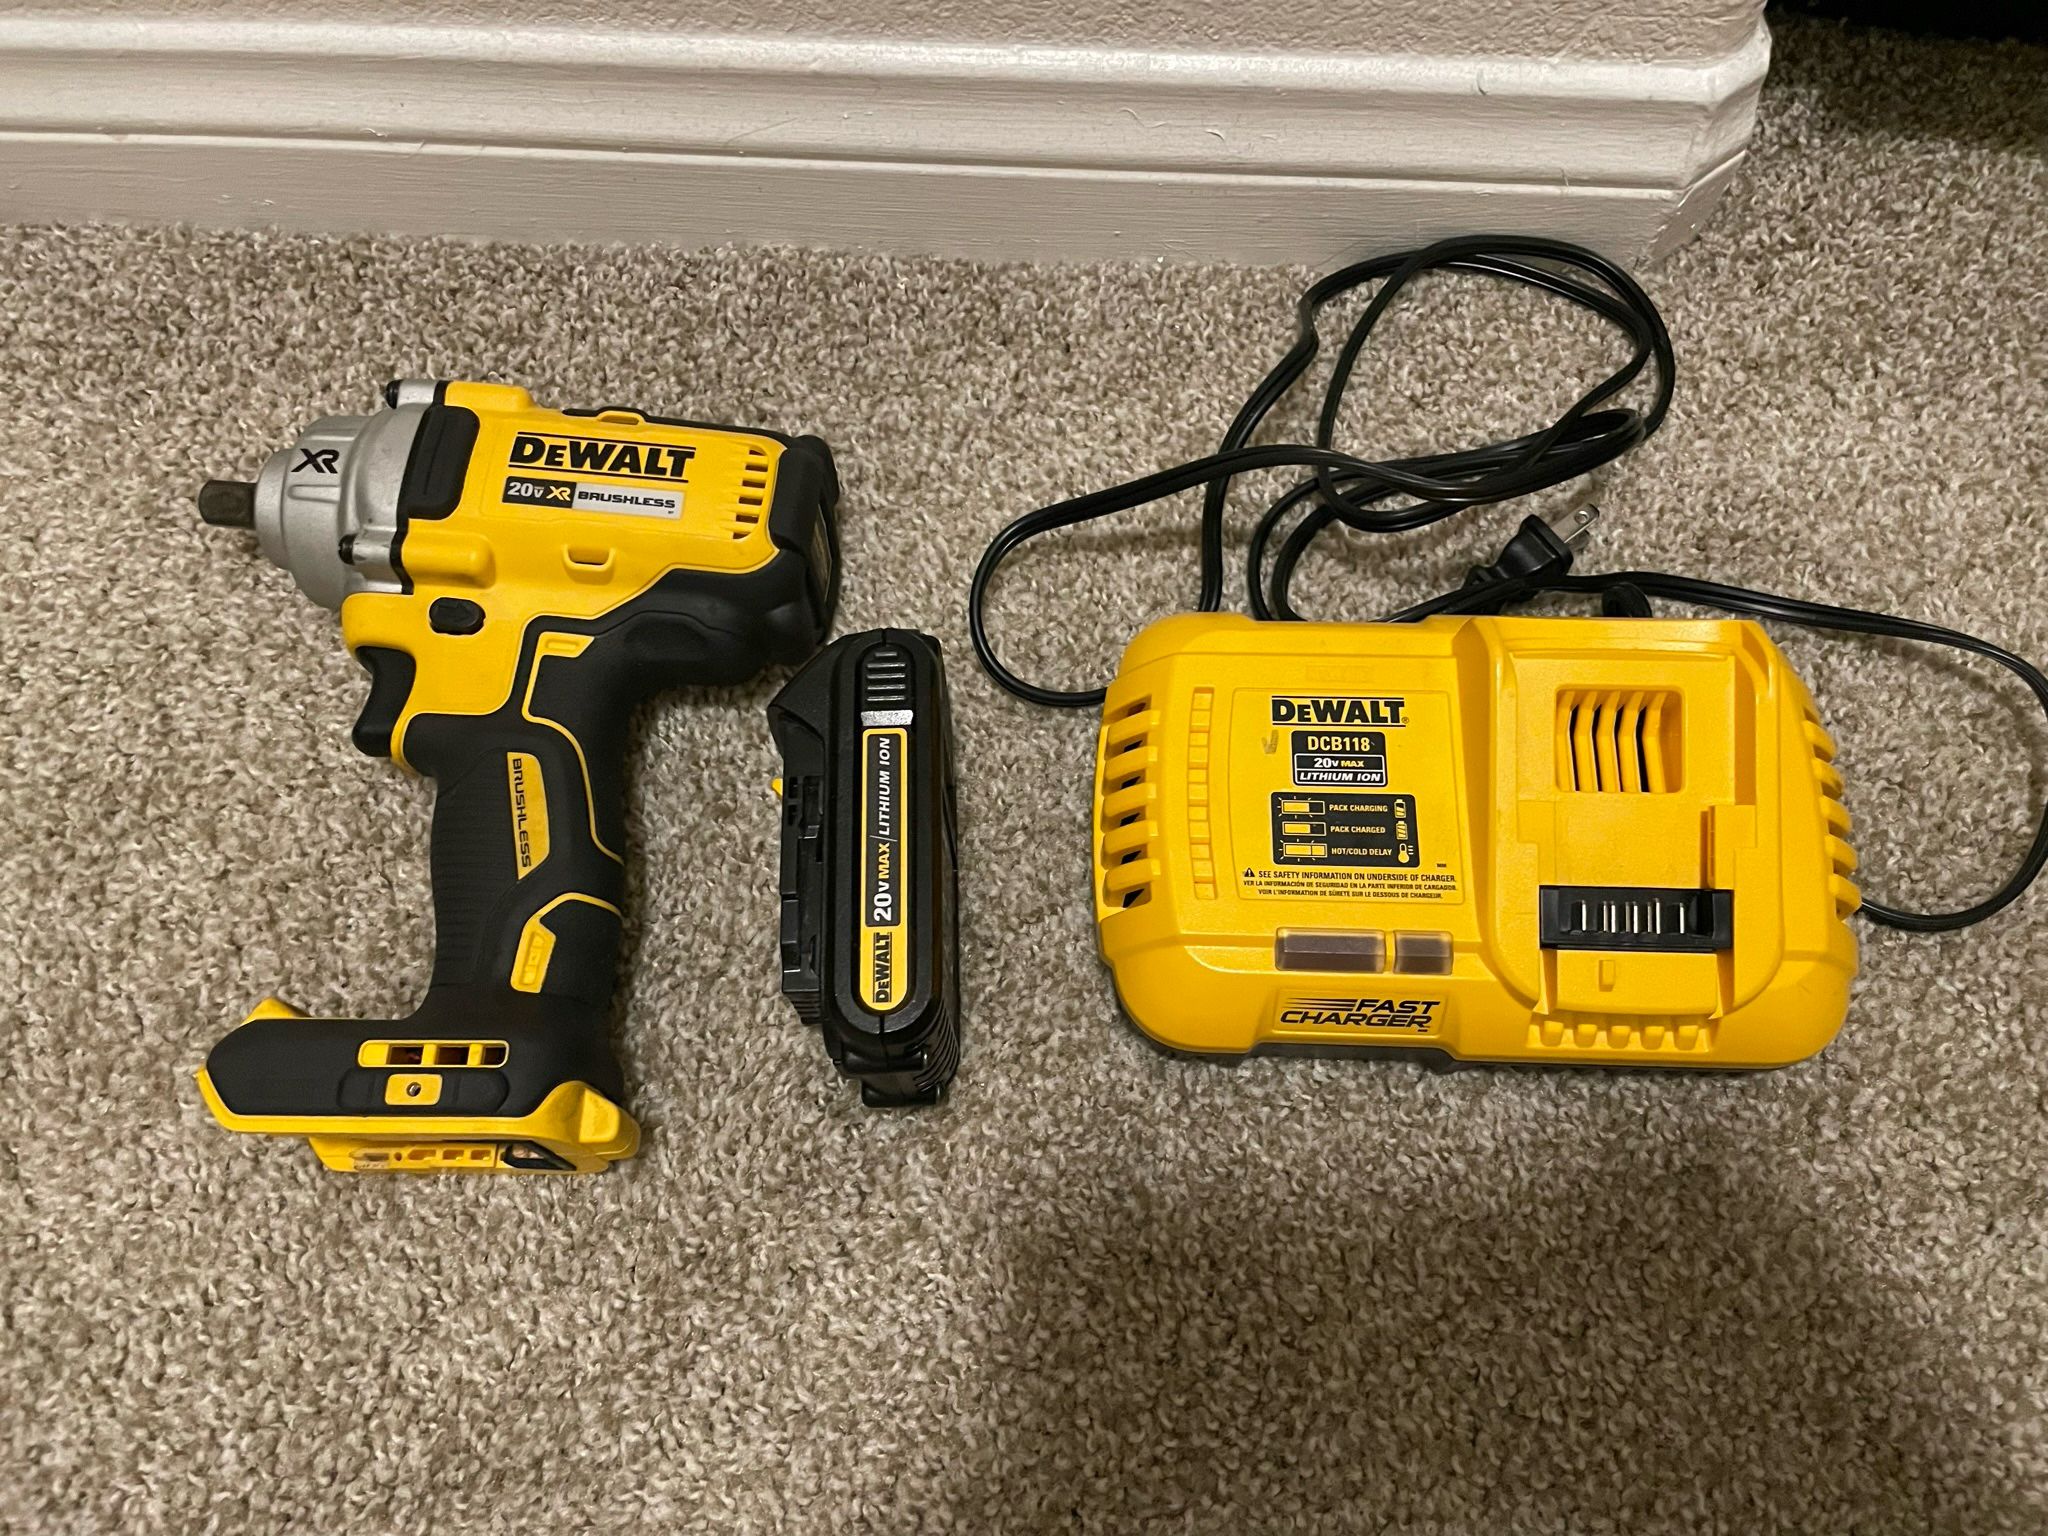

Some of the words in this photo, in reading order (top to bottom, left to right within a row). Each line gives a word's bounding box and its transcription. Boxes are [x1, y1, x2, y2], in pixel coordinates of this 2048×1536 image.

[291, 448, 340, 474] XR
[509, 436, 695, 478] DEWALT
[546, 486, 571, 501] XR
[577, 491, 676, 509] BRUSHLESS
[1272, 699, 1405, 724] DEWALT
[878, 737, 891, 766] ION
[1307, 735, 1371, 752] DCB118
[1340, 760, 1365, 768] MAX
[1299, 772, 1353, 781] LITHIUM
[1356, 773, 1381, 782] ION
[512, 758, 531, 868] BRUSHLESS
[878, 770, 891, 836] LITHIUM
[1329, 804, 1348, 812] PACK
[1349, 804, 1388, 812] CHARGING
[1330, 825, 1350, 833] PACK
[1350, 826, 1386, 834] CHARGED
[878, 842, 890, 879] MAX
[1331, 847, 1368, 855] HOT/COLD
[1369, 848, 1393, 856] DELAY
[1258, 870, 1272, 878] SEE
[1273, 871, 1300, 879] SAFETY
[1301, 872, 1352, 880] INFORMATION
[1354, 872, 1365, 880] ON
[1366, 873, 1408, 881] UNDERSIDE
[874, 932, 892, 1003] DEWALT
[1355, 999, 1441, 1015] FAST
[1280, 1011, 1432, 1028] CHARGER
